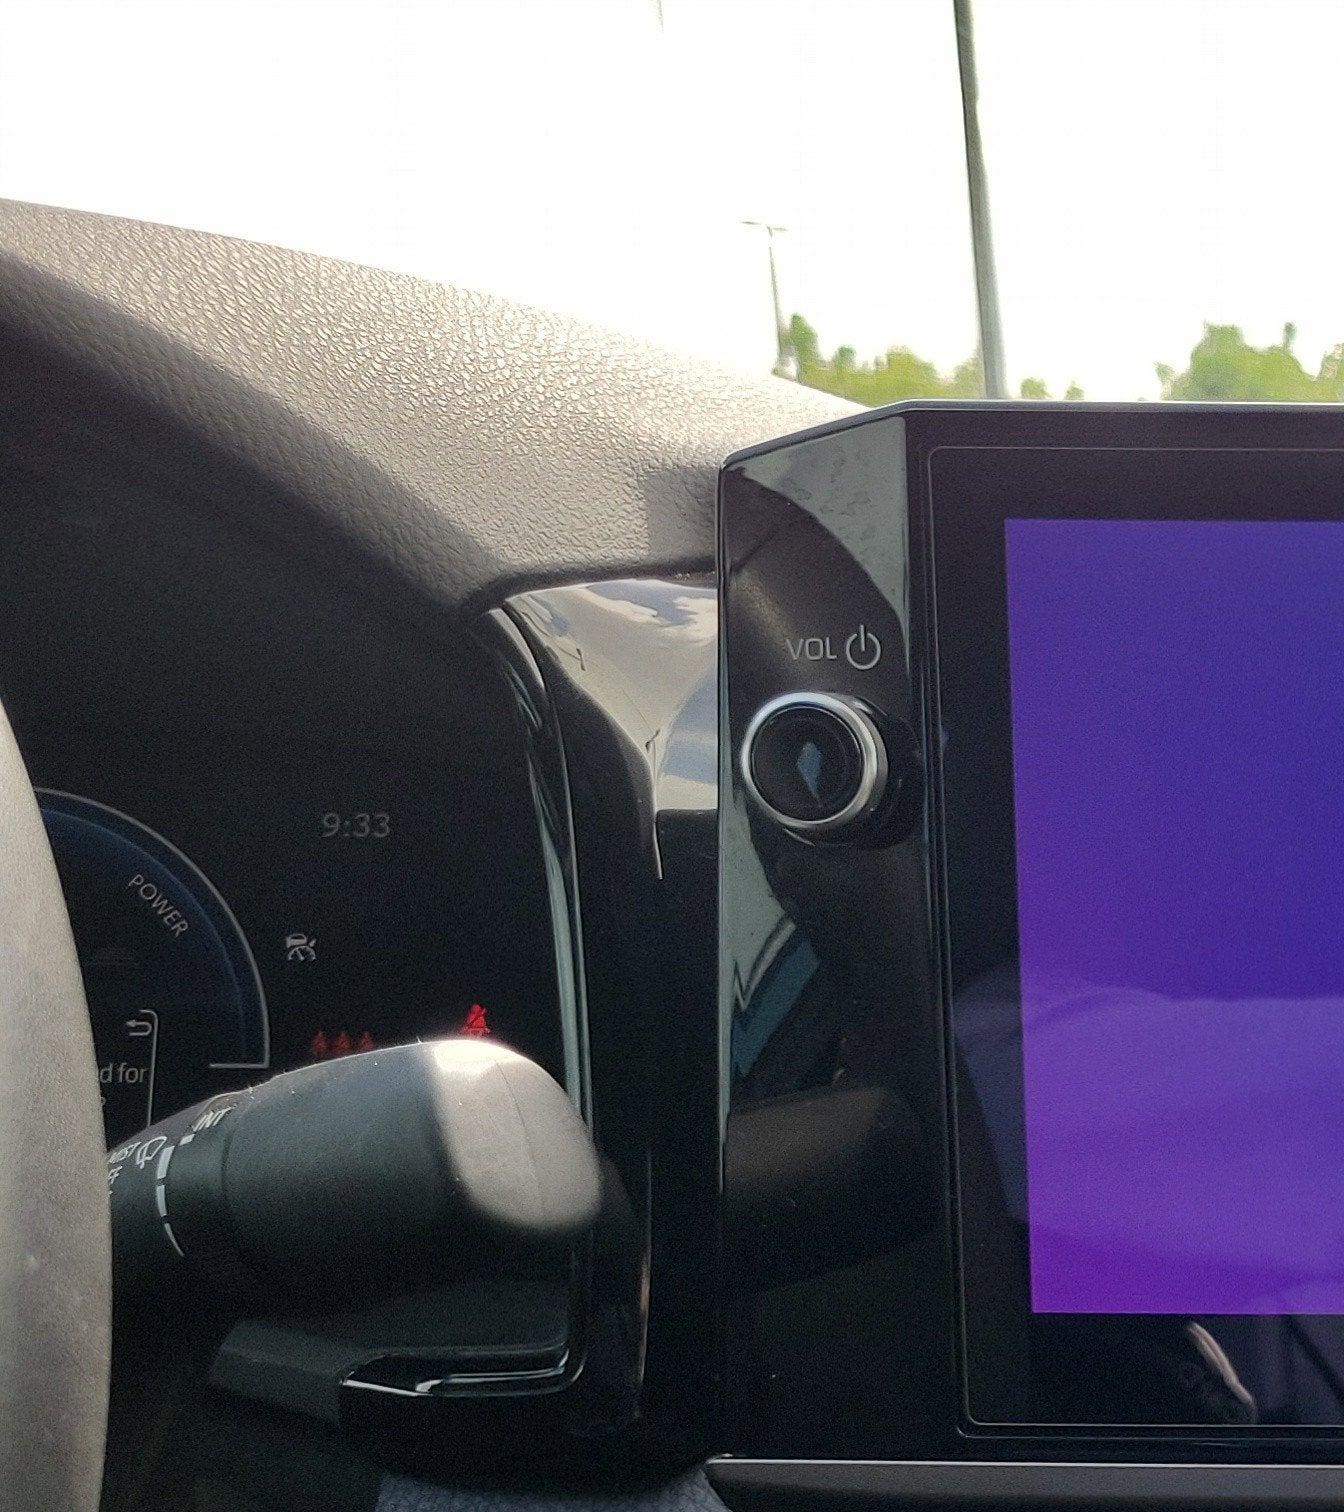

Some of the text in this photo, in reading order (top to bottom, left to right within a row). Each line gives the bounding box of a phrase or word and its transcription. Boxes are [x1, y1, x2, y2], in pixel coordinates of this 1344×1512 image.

[785, 637, 837, 660] VOL
[321, 812, 391, 838] 9:33
[128, 873, 189, 937] POWER
[118, 1062, 147, 1083] for
